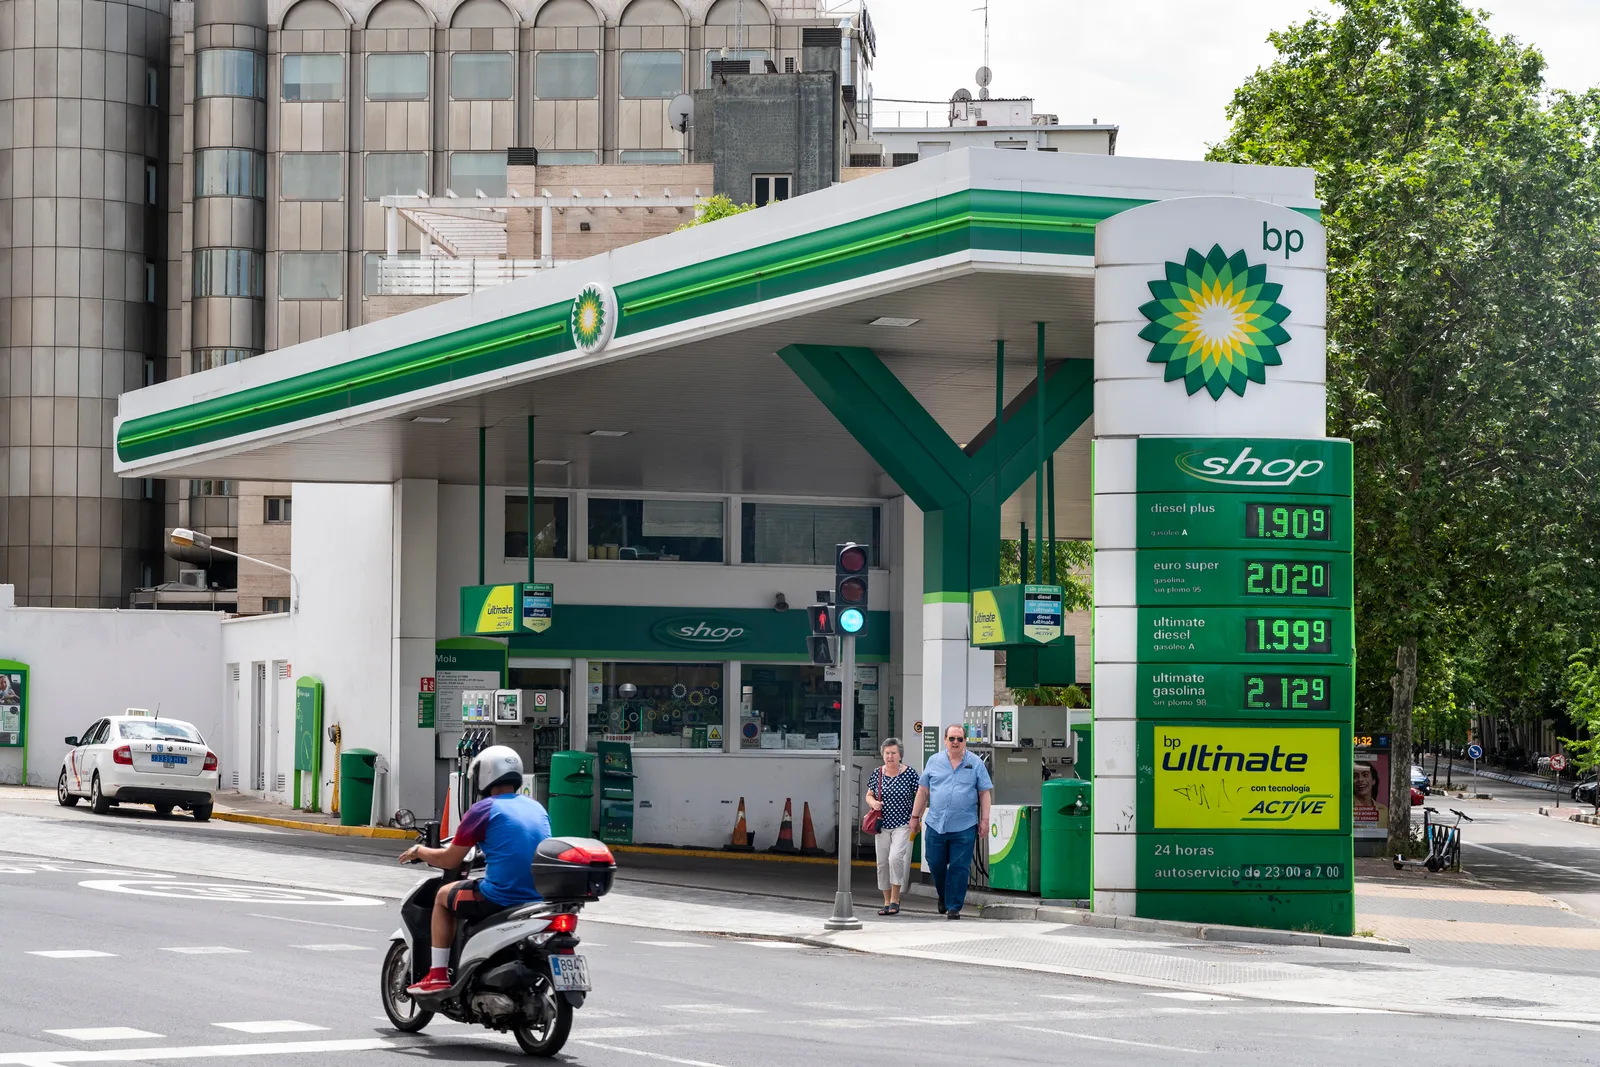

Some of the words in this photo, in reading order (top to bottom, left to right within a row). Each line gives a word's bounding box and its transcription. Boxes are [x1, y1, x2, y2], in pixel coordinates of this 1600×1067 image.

[1262, 221, 1304, 259] bp
[1202, 447, 1324, 486] shop
[1151, 503, 1186, 513] diesel
[1190, 503, 1215, 515] plus
[1153, 562, 1181, 570] euro
[1185, 562, 1219, 572] super
[1247, 563, 1324, 595] 2.020
[1166, 586, 1191, 594] plomo
[487, 604, 513, 615] ultimate
[1153, 617, 1205, 628] ultimate
[680, 621, 744, 642] shop
[1153, 629, 1190, 640] diesel
[1257, 619, 1325, 650] 1.999
[1153, 673, 1205, 683] ultimate
[1153, 685, 1205, 698] gasolina
[1167, 699, 1193, 707] plomo
[1163, 735, 1181, 750] bp
[1162, 744, 1308, 772] ultimate
[1248, 800, 1326, 814] ACTIVE
[1154, 844, 1171, 856] 24
[1175, 844, 1214, 856] horas
[1154, 866, 1240, 878] autoservicio
[1244, 866, 1260, 878] de
[1305, 869, 1311, 878] a
